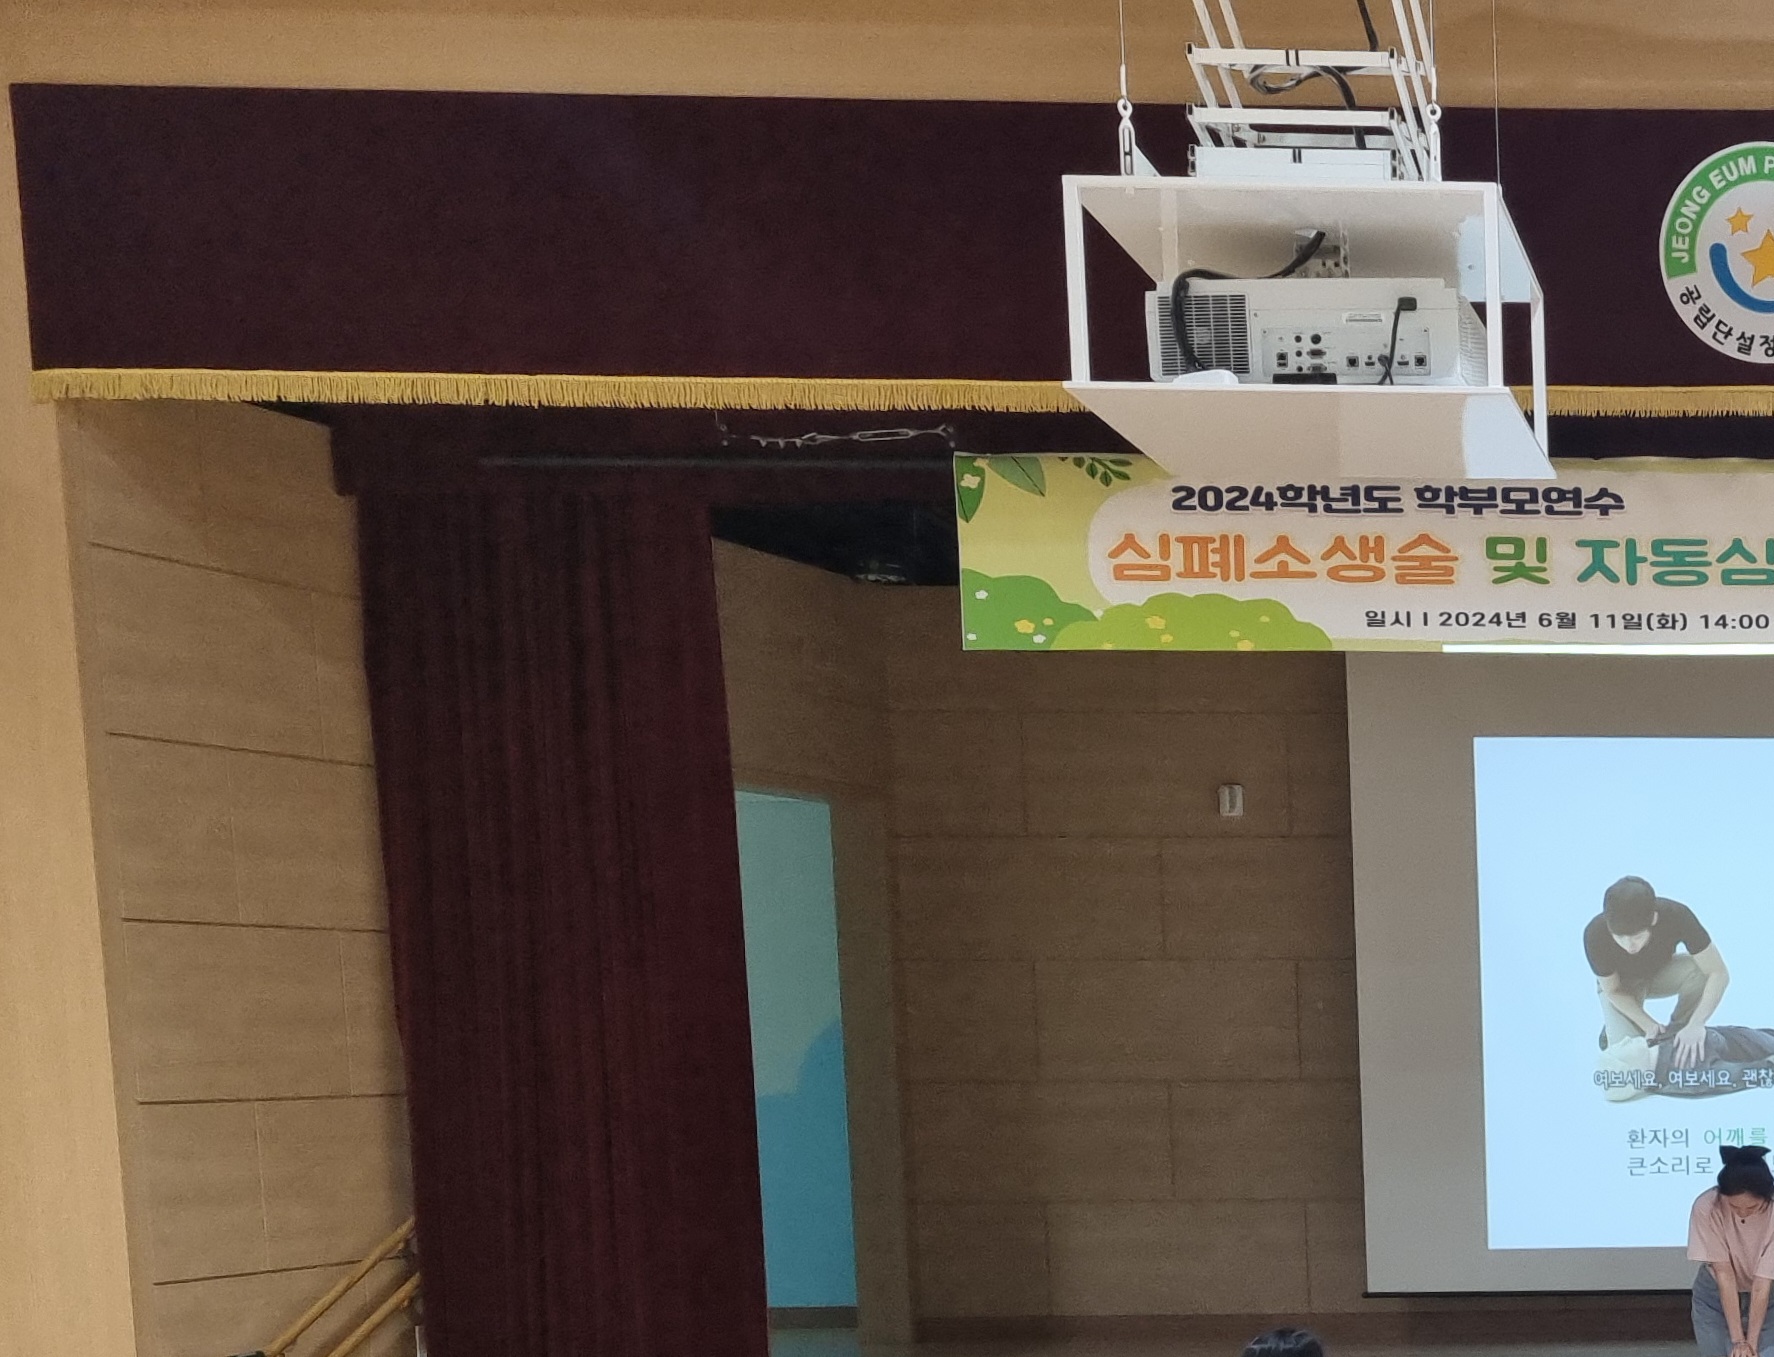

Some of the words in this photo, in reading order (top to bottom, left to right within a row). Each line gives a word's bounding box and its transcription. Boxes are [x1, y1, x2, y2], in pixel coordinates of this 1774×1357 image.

[1671, 185, 1712, 263] JEONG
[1708, 155, 1757, 190] EUM
[1171, 484, 1403, 516] 2024학년도
[1414, 484, 1626, 517] 학부모연수
[1107, 532, 1459, 586] 심폐소생술
[1484, 536, 1551, 585] 및
[1365, 610, 1412, 629] 일시
[1439, 611, 1527, 629] 2024년
[1538, 611, 1577, 630] 6월
[1590, 612, 1688, 632] 11일(화)
[1699, 614, 1771, 631] 14:00
[1593, 1069, 1663, 1089] 여보세요,
[1626, 1128, 1690, 1149] 환자의
[1626, 1155, 1714, 1176] 큰소리로
